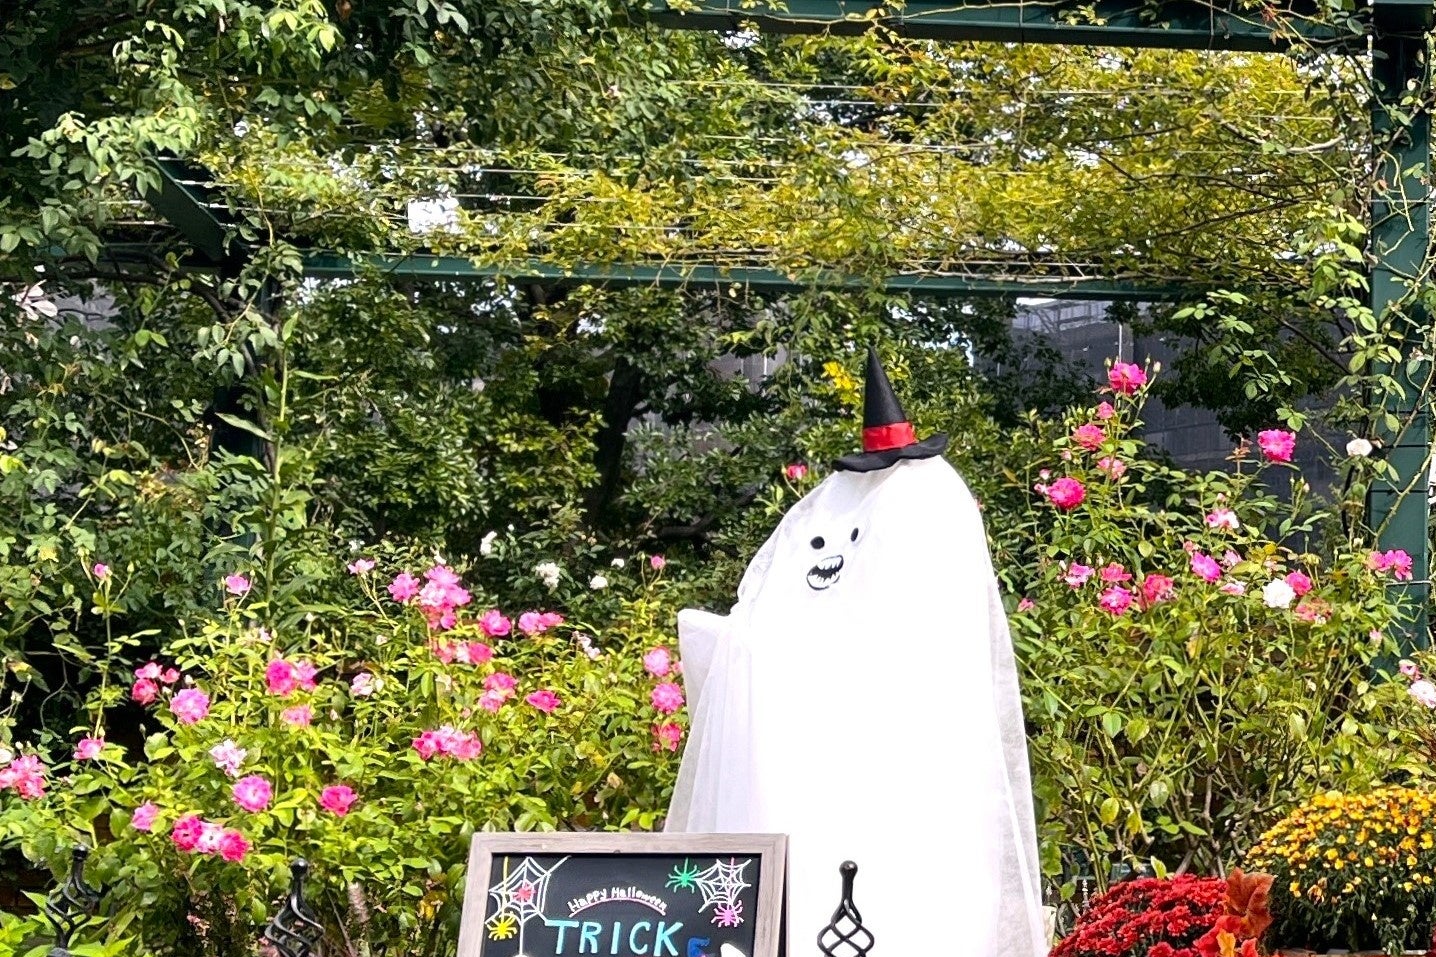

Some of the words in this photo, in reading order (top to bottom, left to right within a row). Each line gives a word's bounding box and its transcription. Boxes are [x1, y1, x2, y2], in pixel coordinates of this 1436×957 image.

[567, 888, 607, 912] Happy
[611, 886, 667, 911] Halloween
[545, 919, 684, 957] TRICK
